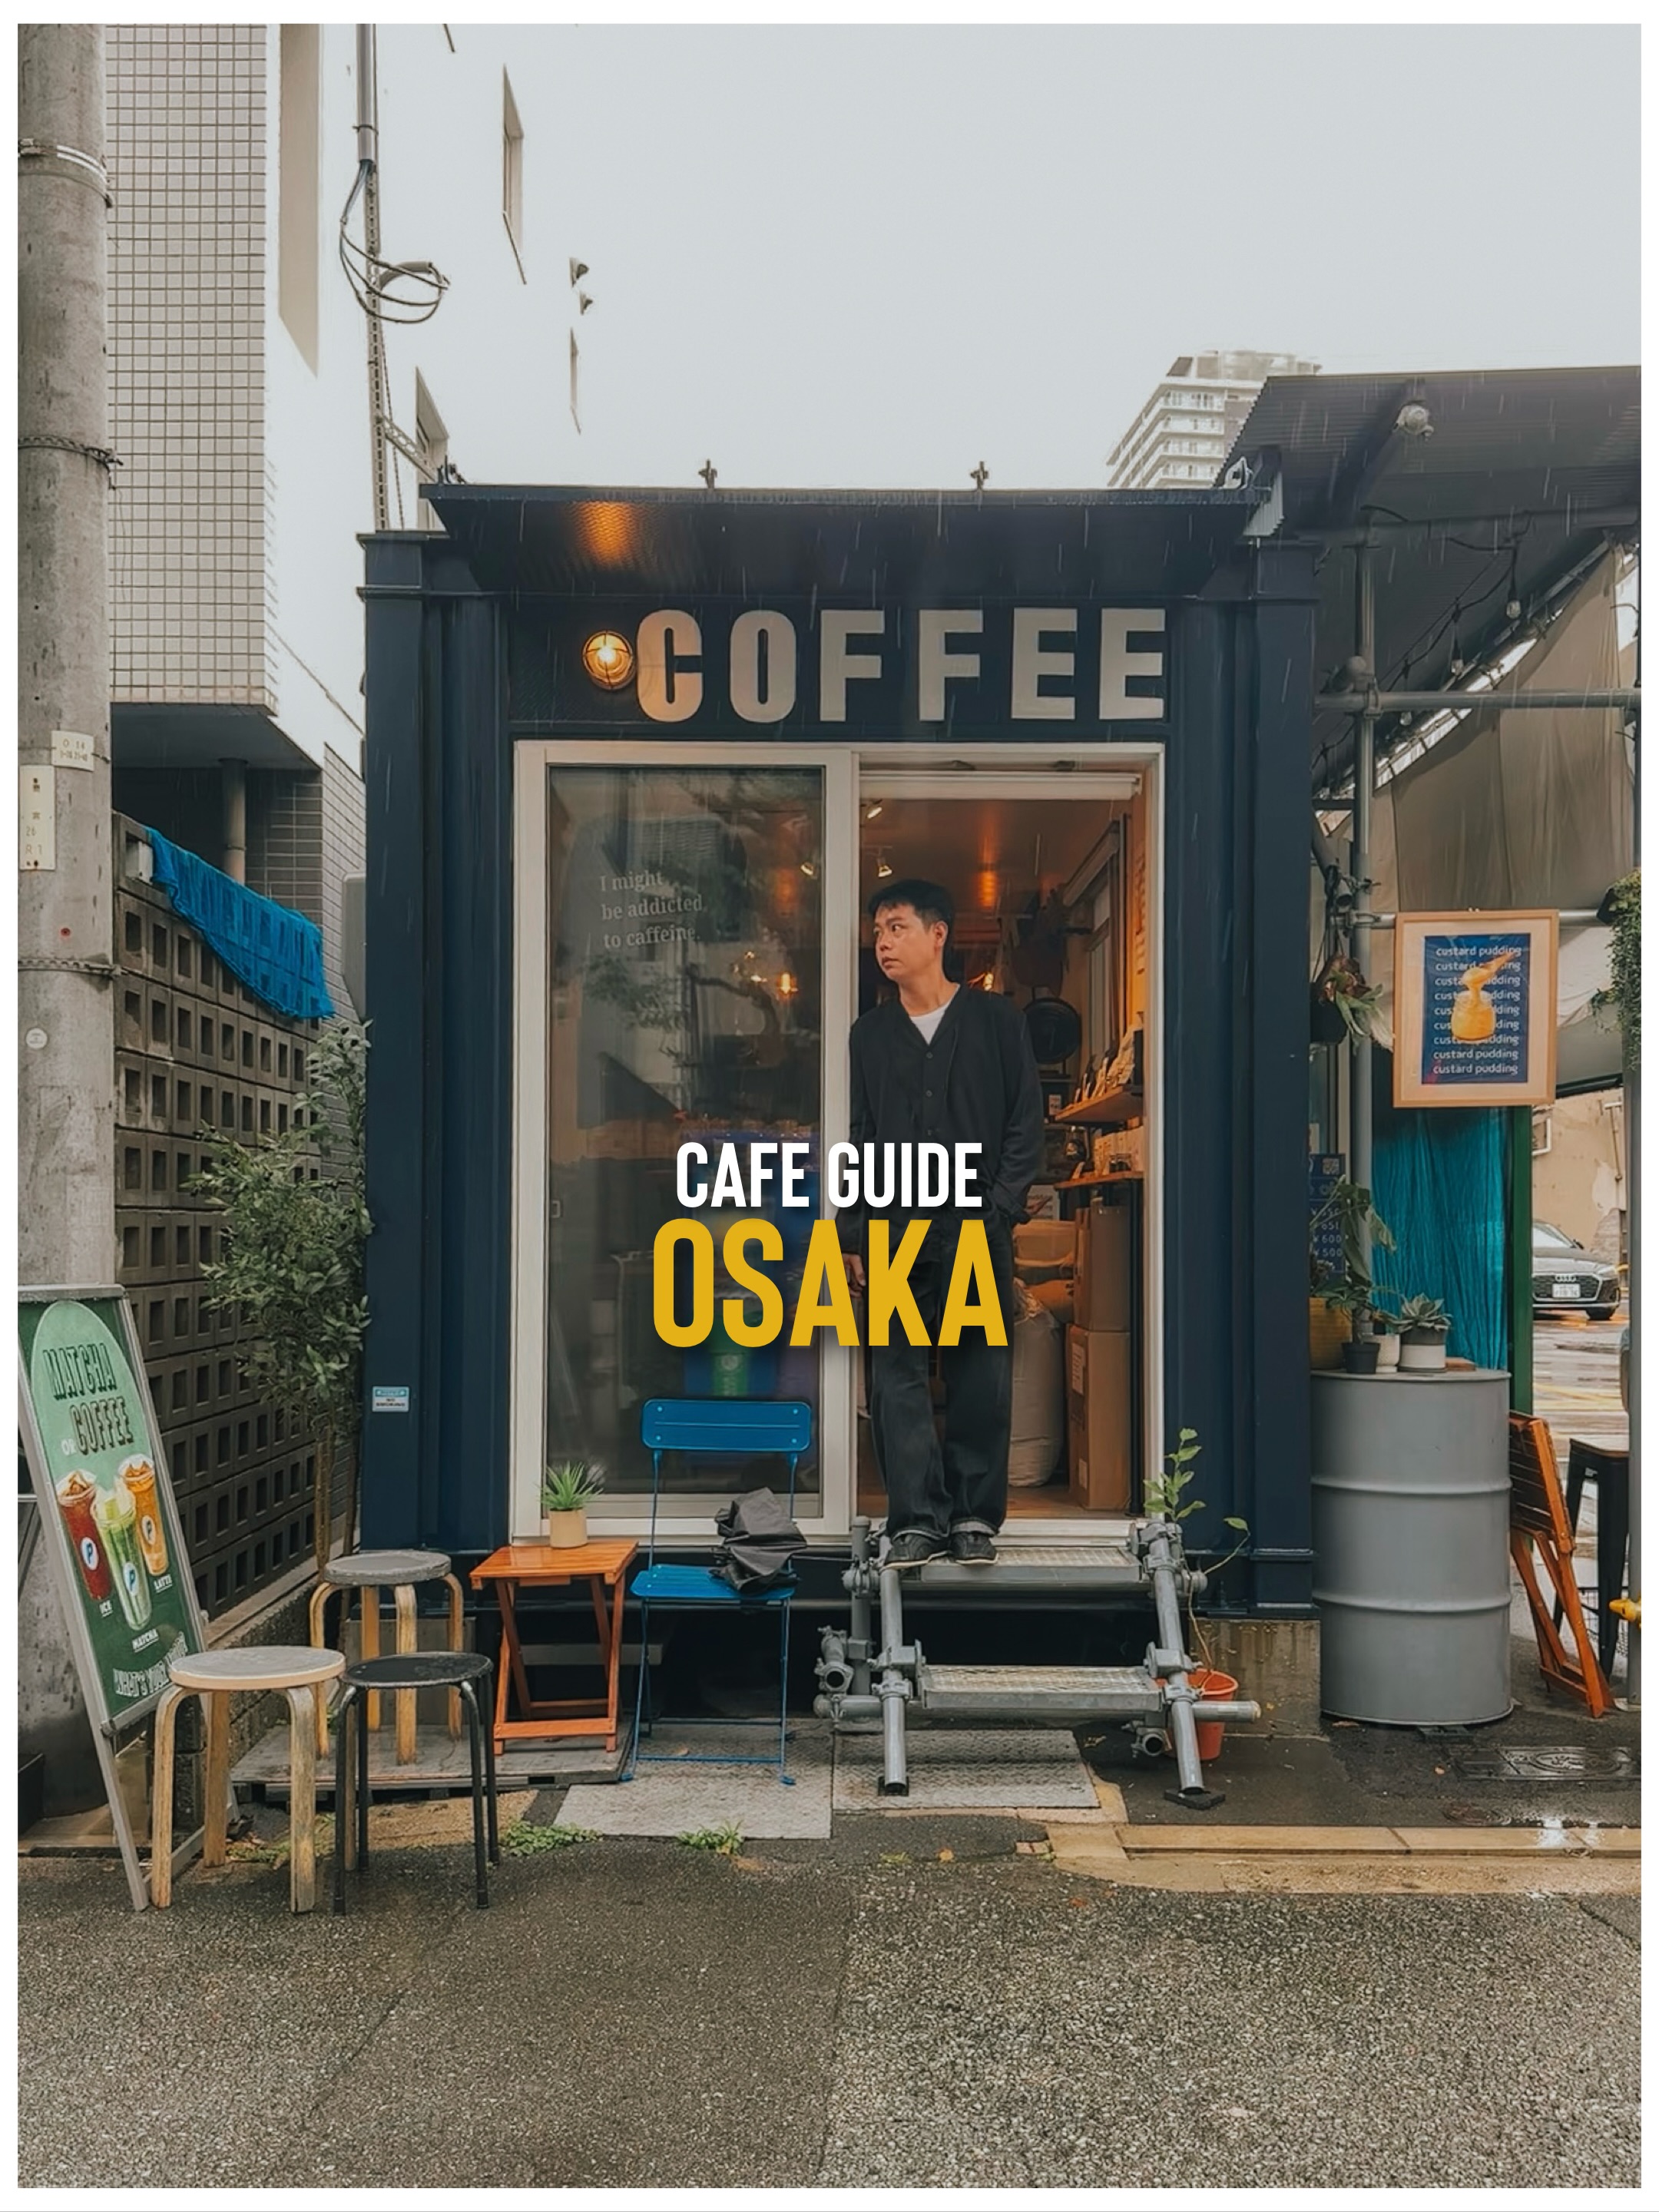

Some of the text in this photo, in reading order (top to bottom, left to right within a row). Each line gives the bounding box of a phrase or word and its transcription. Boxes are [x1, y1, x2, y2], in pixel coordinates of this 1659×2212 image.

[636, 608, 1166, 723] COFFEE
[601, 869, 664, 892] I might
[601, 893, 703, 920] be addicted
[604, 924, 700, 949] to caffeine.
[1435, 945, 1522, 957] custard pudding
[1433, 1048, 1519, 1061] custard pudding
[1432, 1063, 1518, 1076] custard pudding
[43, 1343, 117, 1400] MATCHA
[70, 1396, 134, 1455] COFFEE
[131, 1628, 159, 1651] MATCHA
